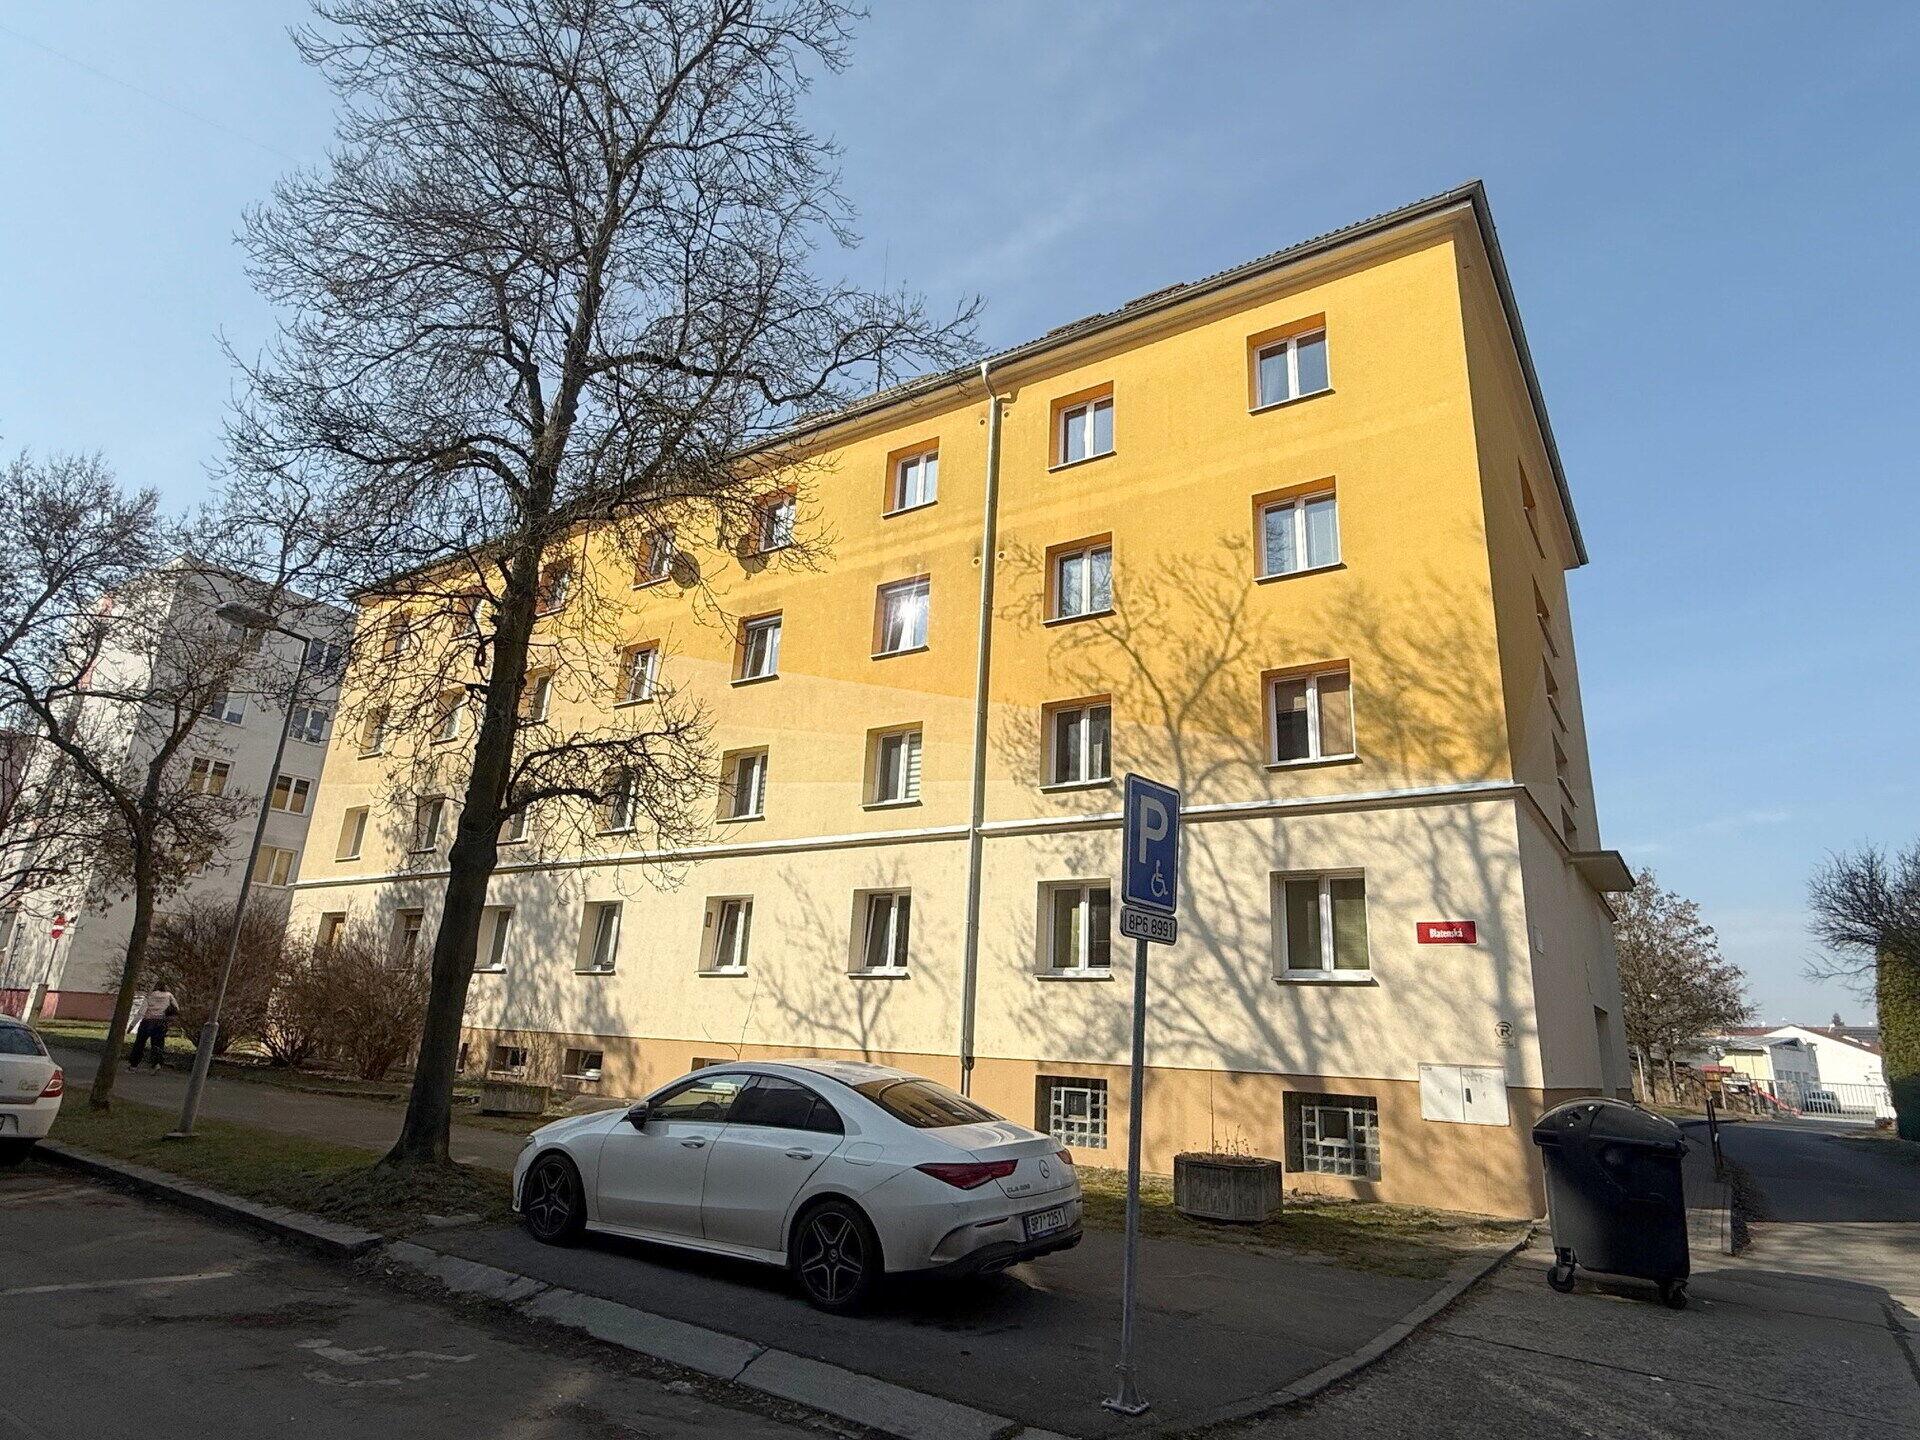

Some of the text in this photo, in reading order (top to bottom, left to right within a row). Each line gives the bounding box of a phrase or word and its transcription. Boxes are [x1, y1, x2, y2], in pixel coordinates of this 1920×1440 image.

[1139, 795, 1168, 864] P
[1129, 914, 1173, 938] 8P6 8991
